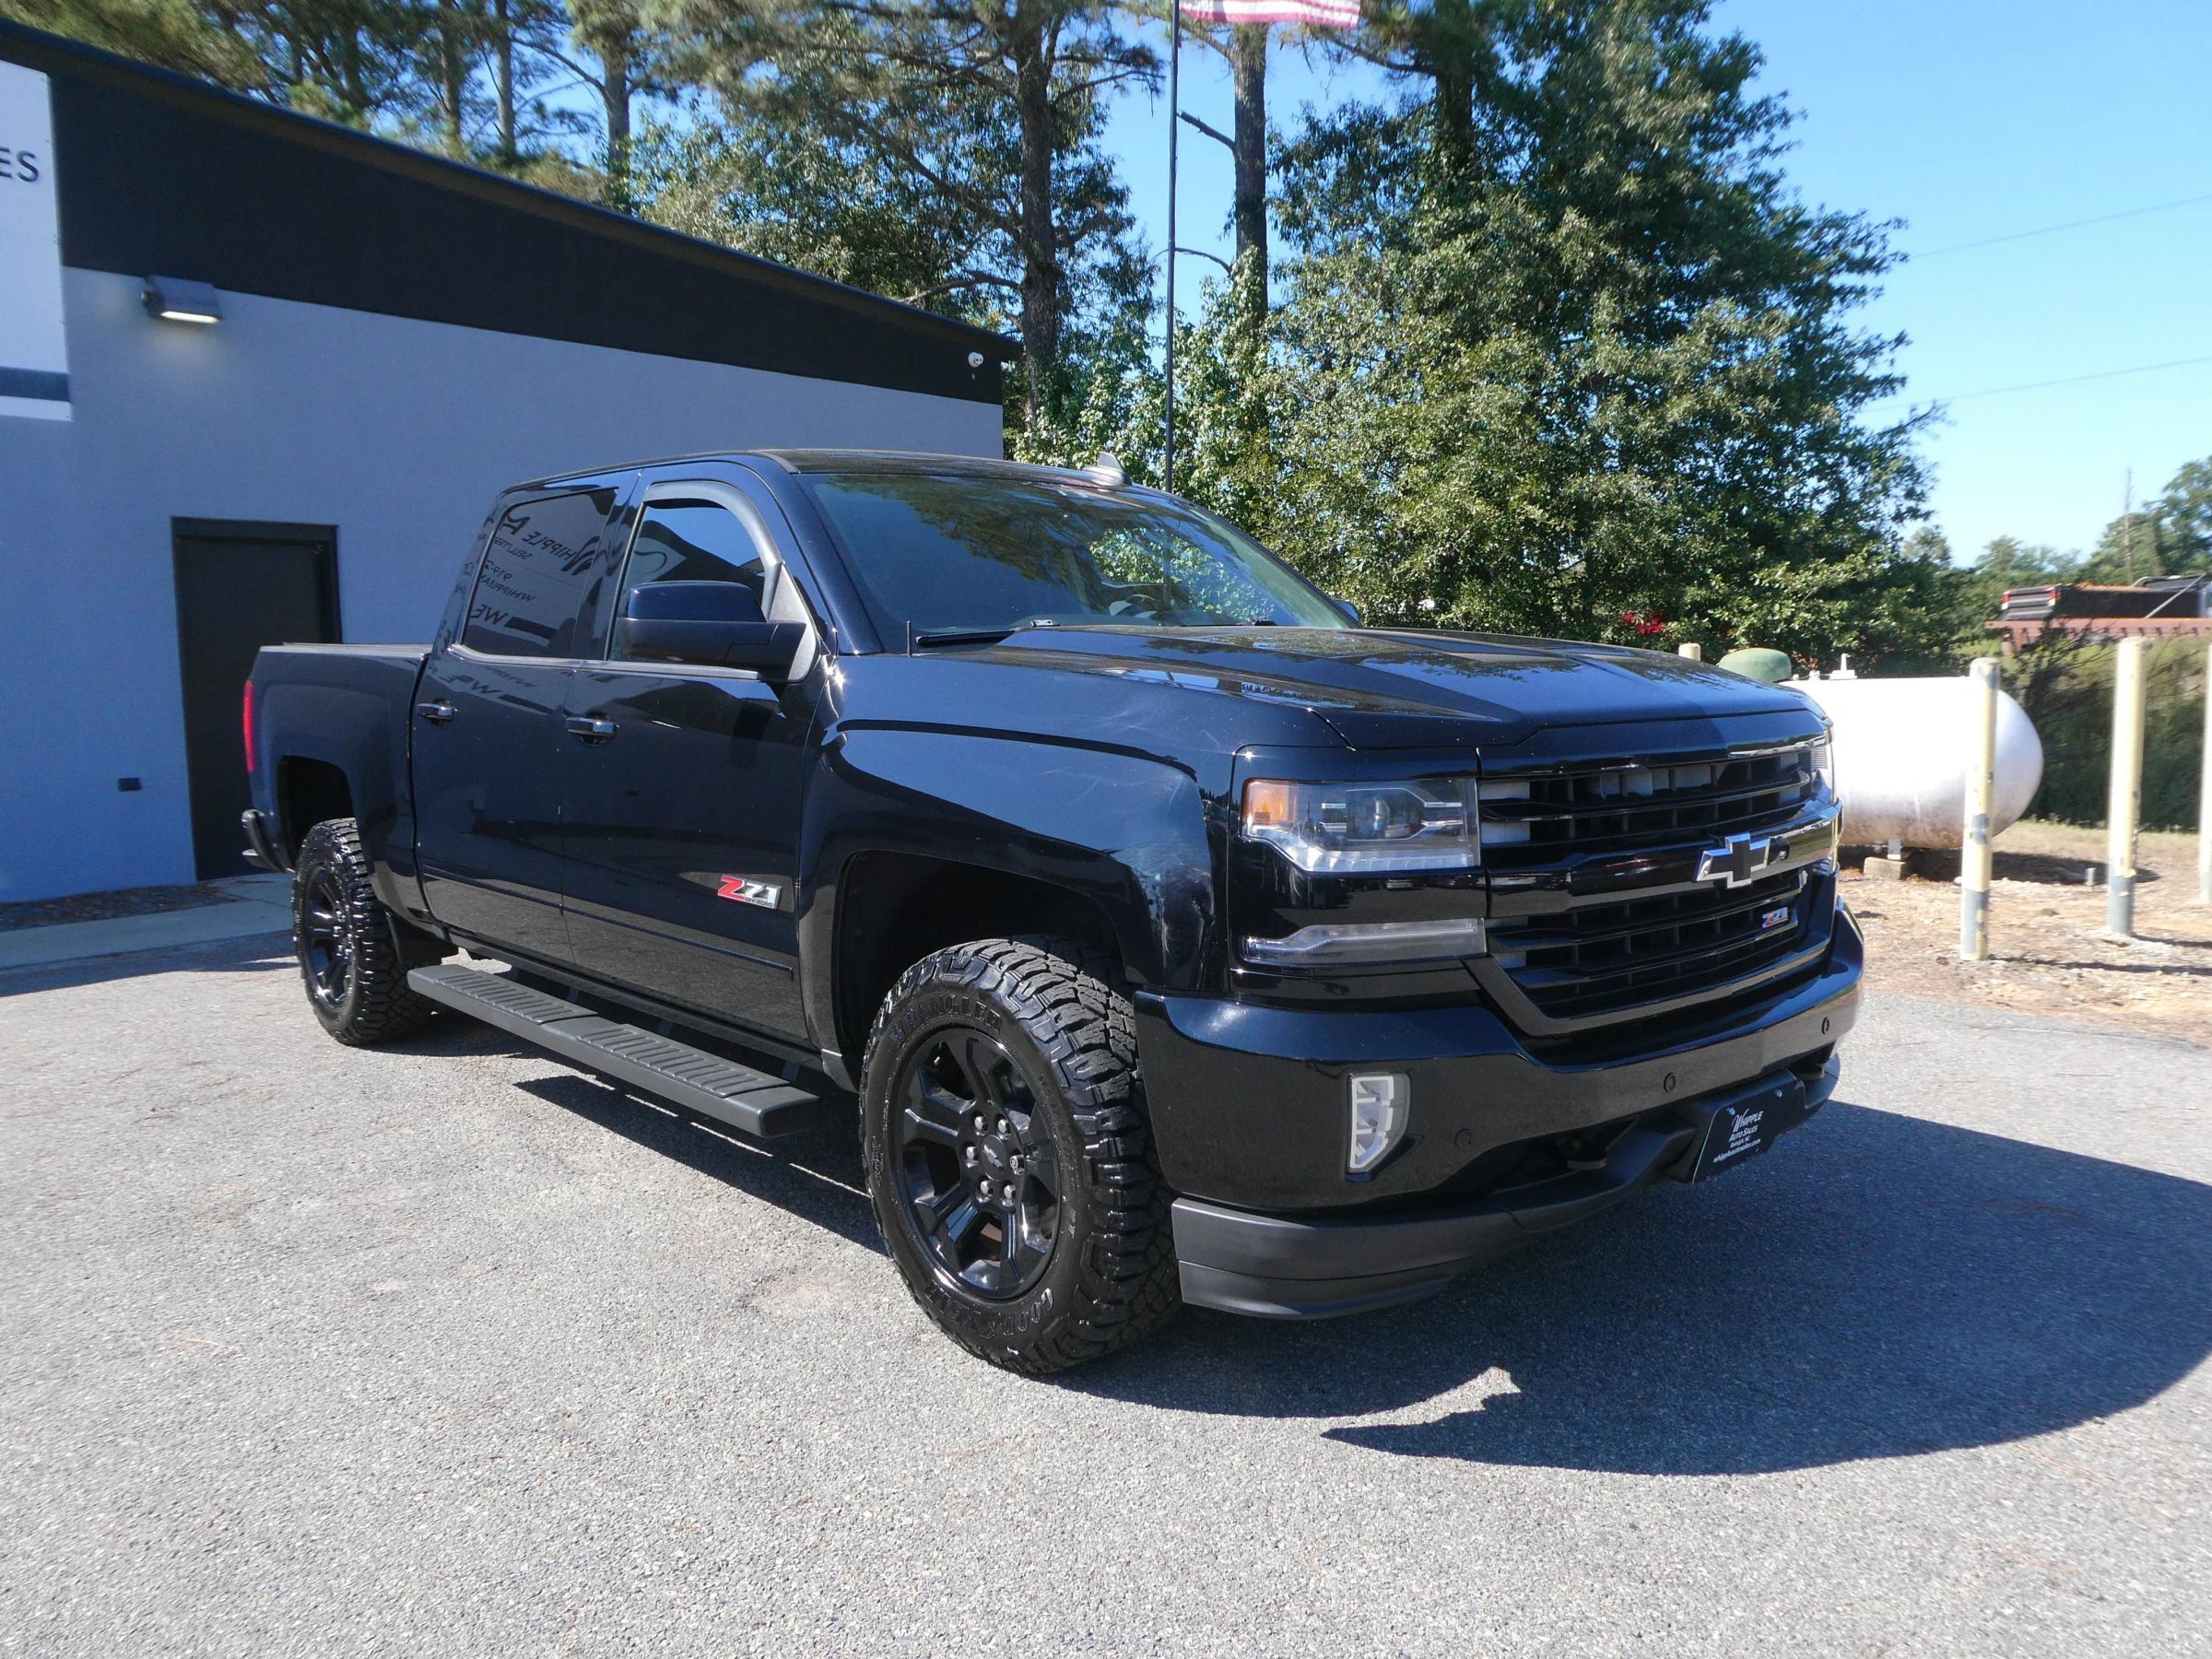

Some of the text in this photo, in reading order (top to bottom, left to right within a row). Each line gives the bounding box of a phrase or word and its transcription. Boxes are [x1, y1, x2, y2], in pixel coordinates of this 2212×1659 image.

[717, 875, 782, 909] Z71
[1761, 906, 1788, 928] Z71
[888, 994, 1004, 1043] WRANGLER
